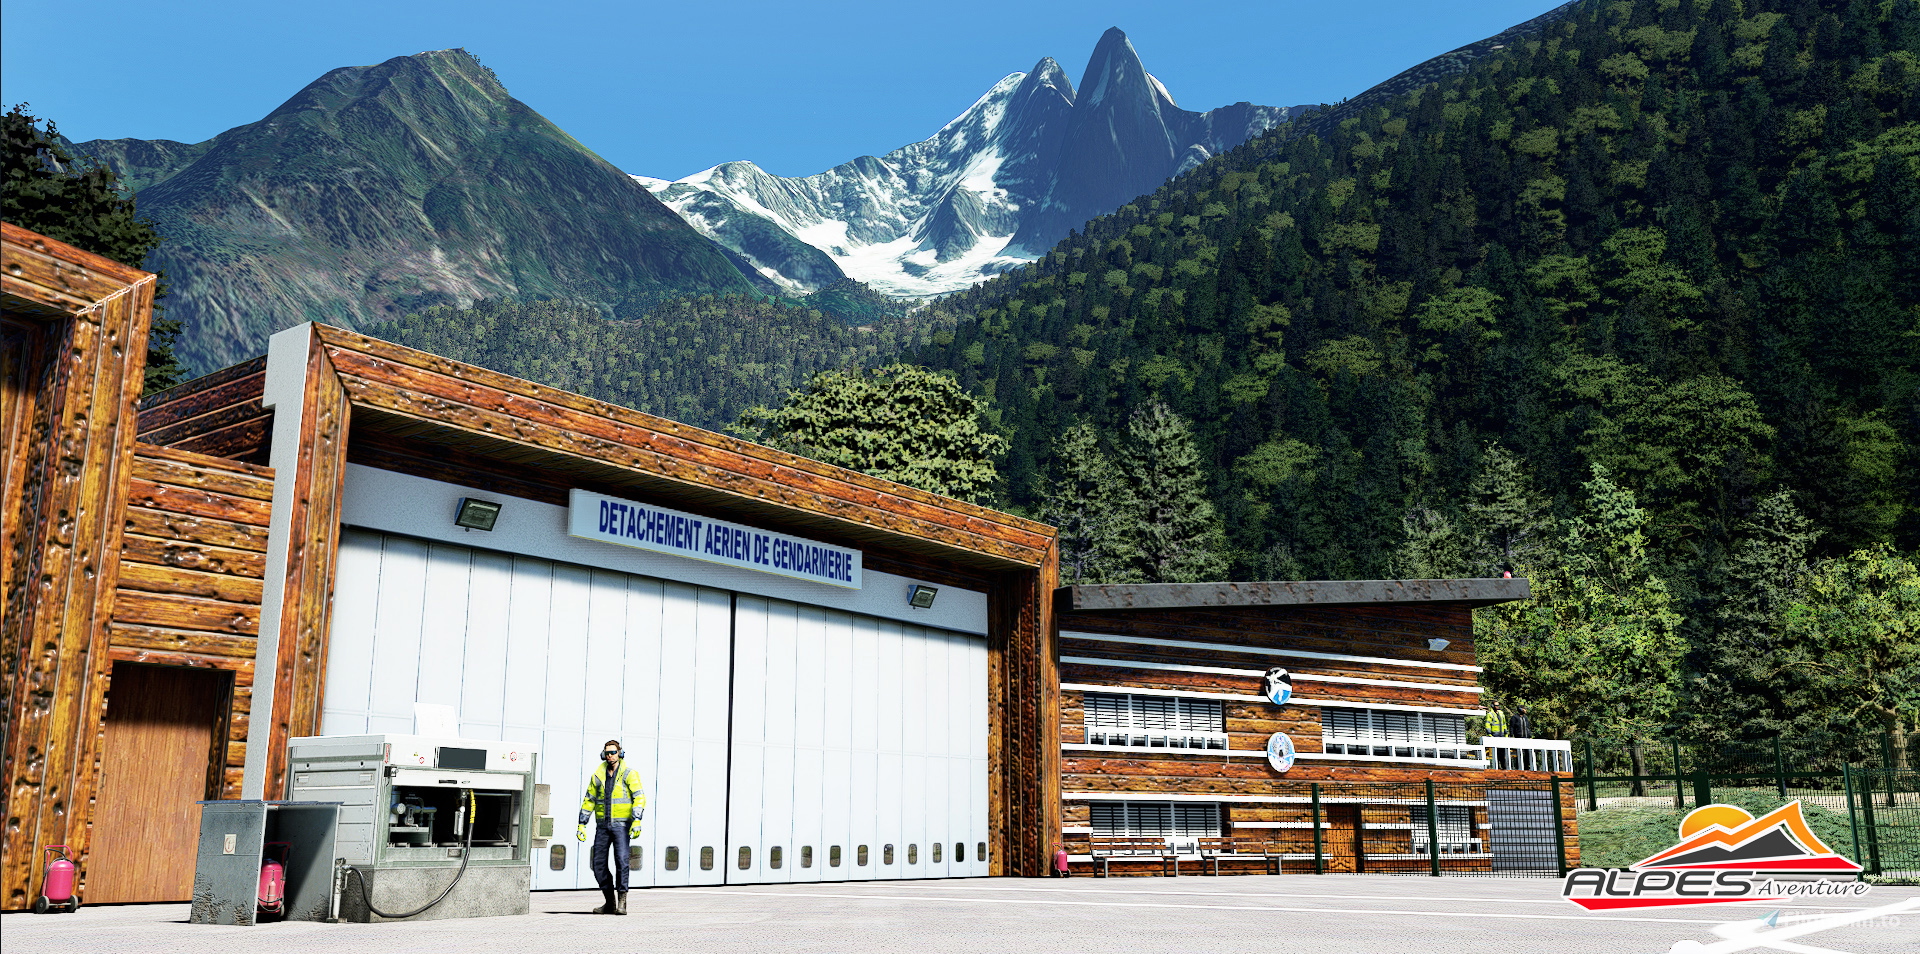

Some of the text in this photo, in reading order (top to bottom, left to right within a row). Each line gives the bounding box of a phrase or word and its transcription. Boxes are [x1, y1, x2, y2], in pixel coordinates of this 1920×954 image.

[599, 500, 853, 583] DETACHEMENT AERIEN DE GENDARMERIE
